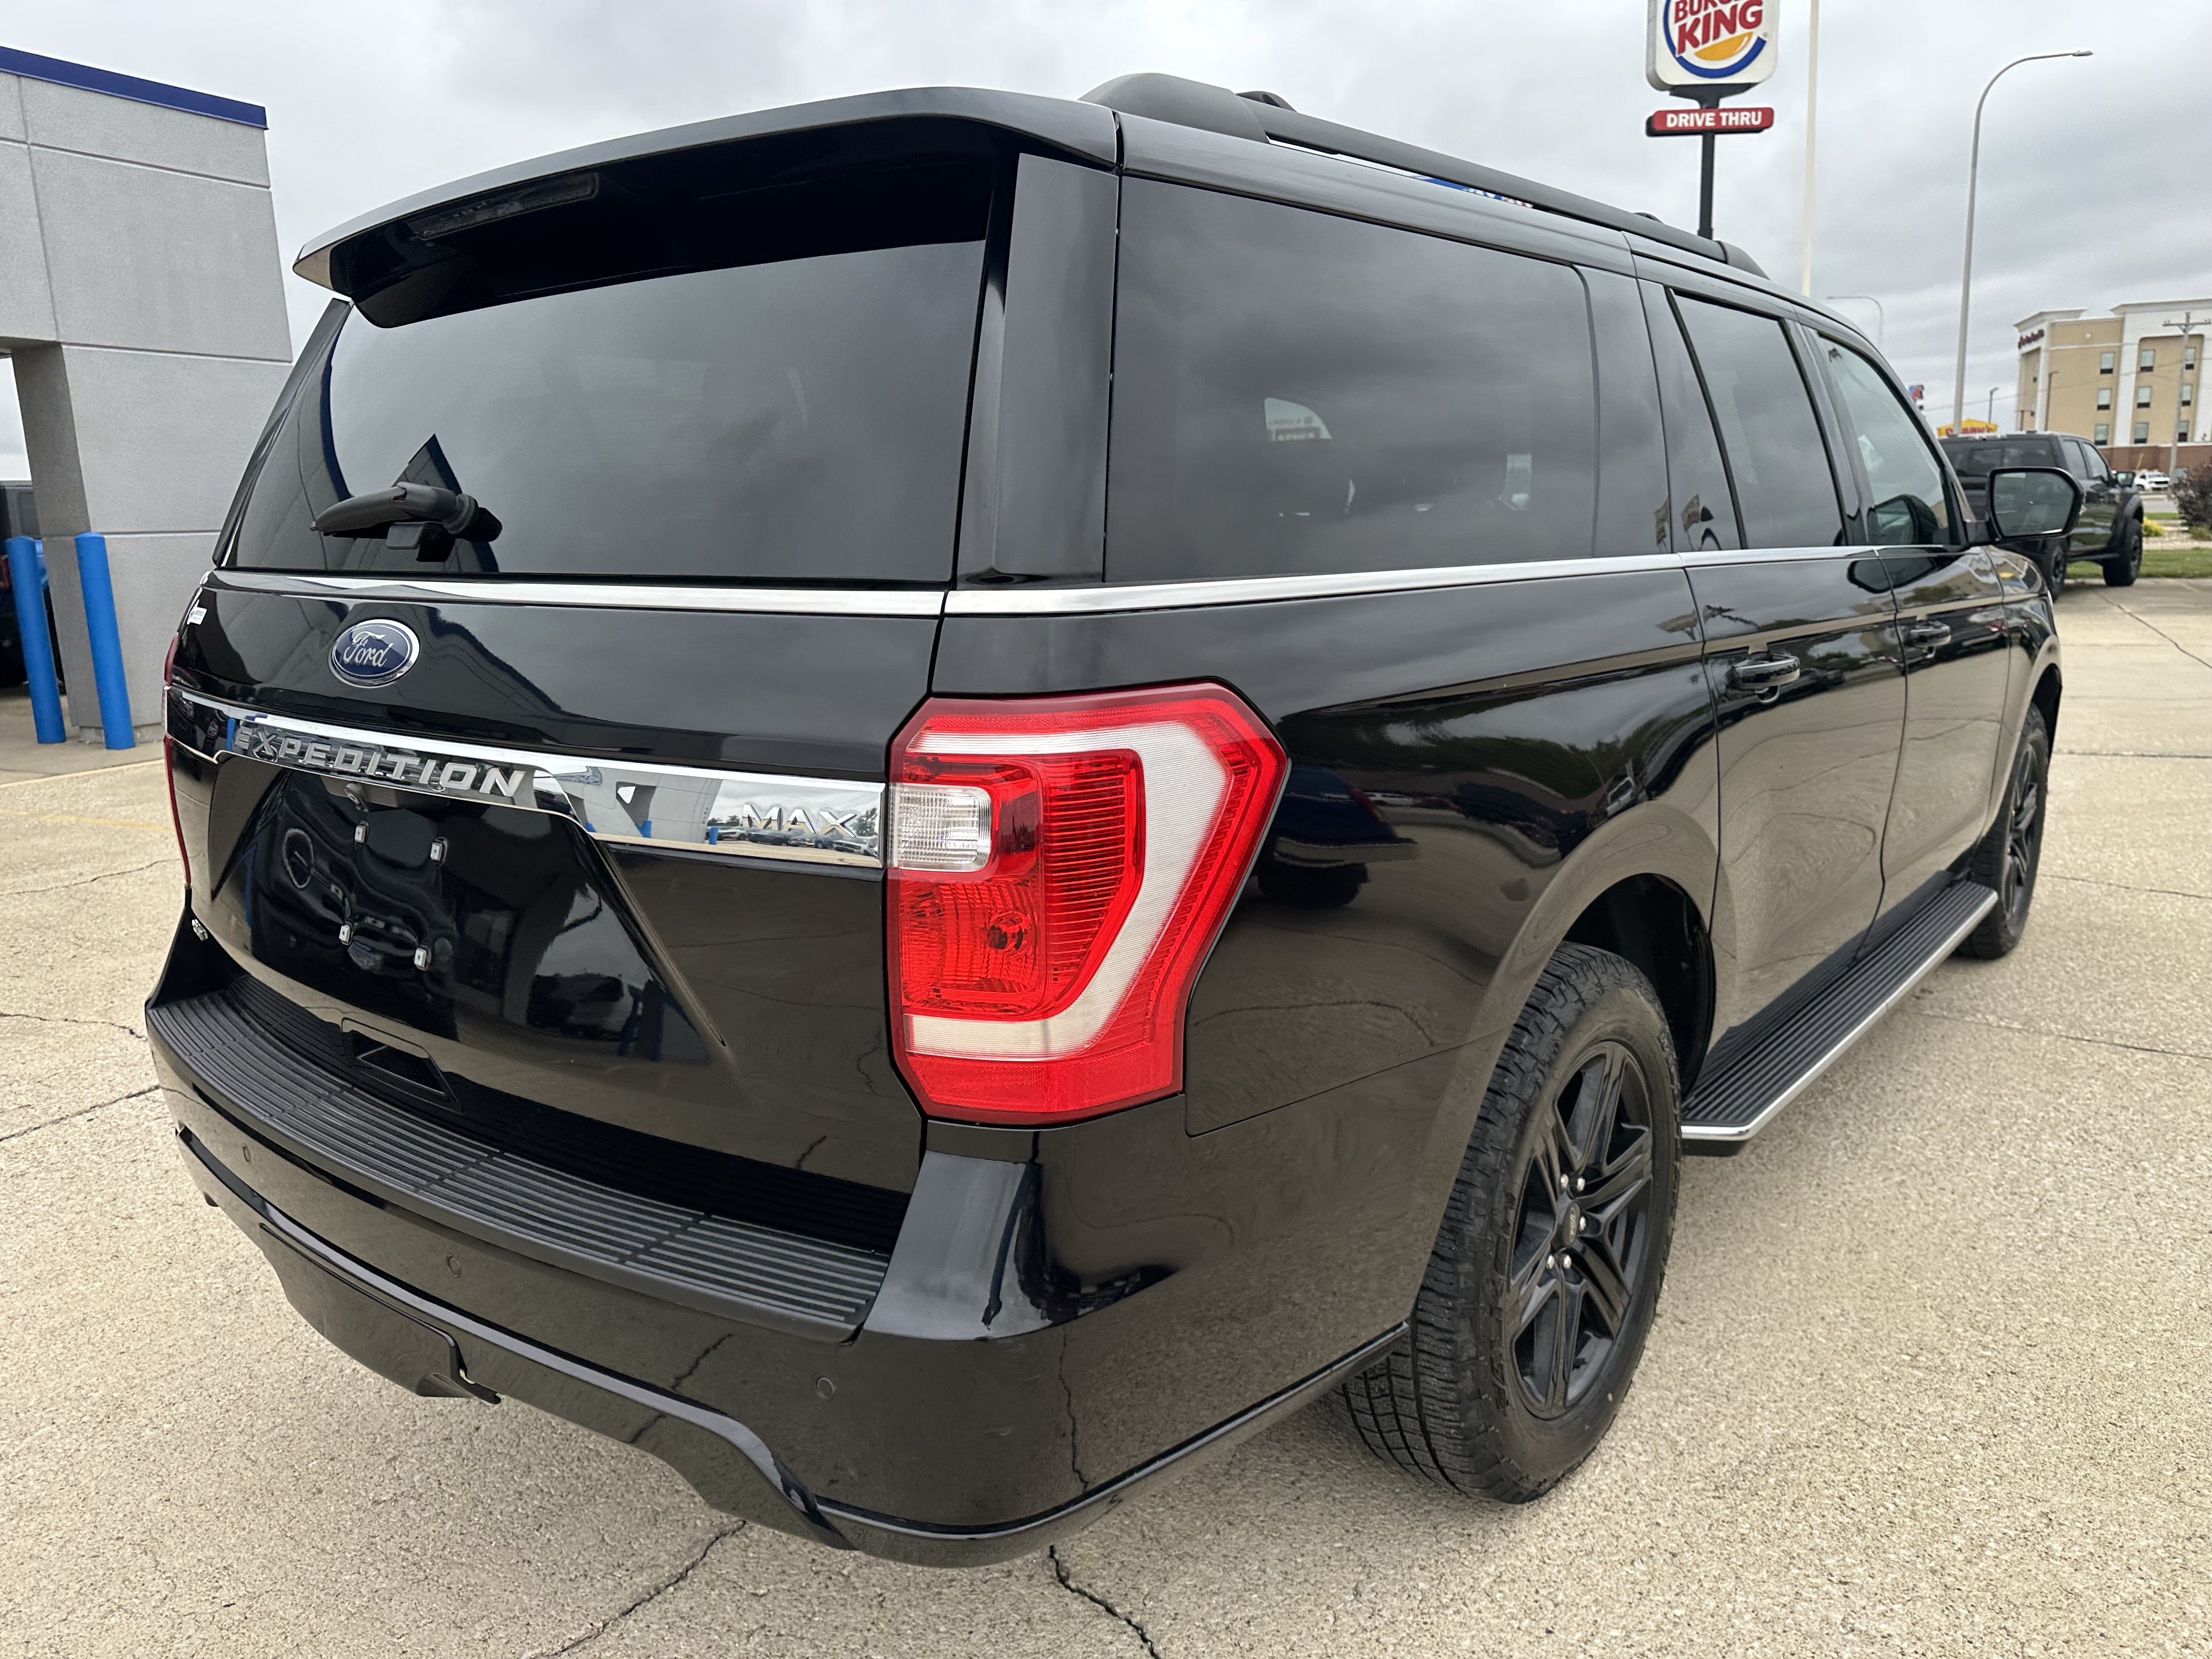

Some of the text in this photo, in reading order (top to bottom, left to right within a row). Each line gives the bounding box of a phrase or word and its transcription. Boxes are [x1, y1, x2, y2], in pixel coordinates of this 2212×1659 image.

[1678, 0, 1763, 55] KING
[1666, 111, 1762, 127] DRIVE THRU
[343, 631, 394, 668] Ford
[234, 726, 526, 797] EXPEDITION
[742, 804, 857, 838] MAX
